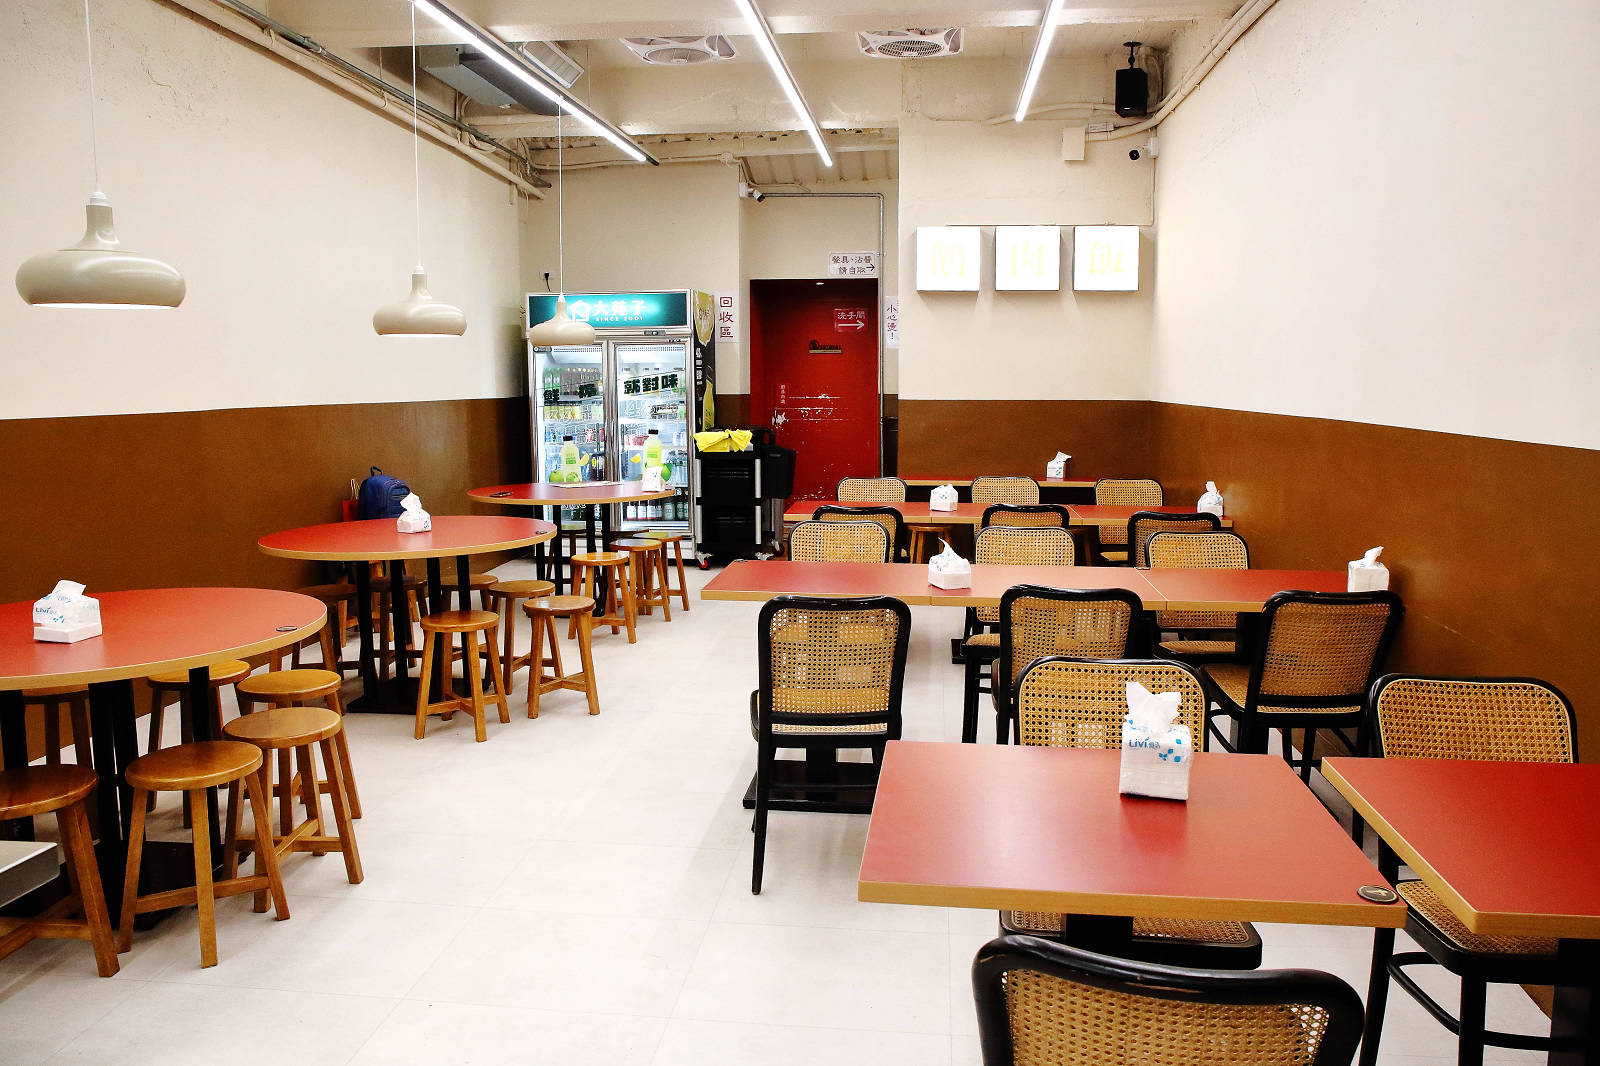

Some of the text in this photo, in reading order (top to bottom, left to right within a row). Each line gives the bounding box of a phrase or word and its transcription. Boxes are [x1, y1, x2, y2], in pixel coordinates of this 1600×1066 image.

[839, 266, 866, 275] 請自取
[592, 300, 646, 316] 大苑子
[837, 311, 866, 320] 洗手間
[719, 296, 734, 338] 回收區
[623, 374, 678, 395] 就對味
